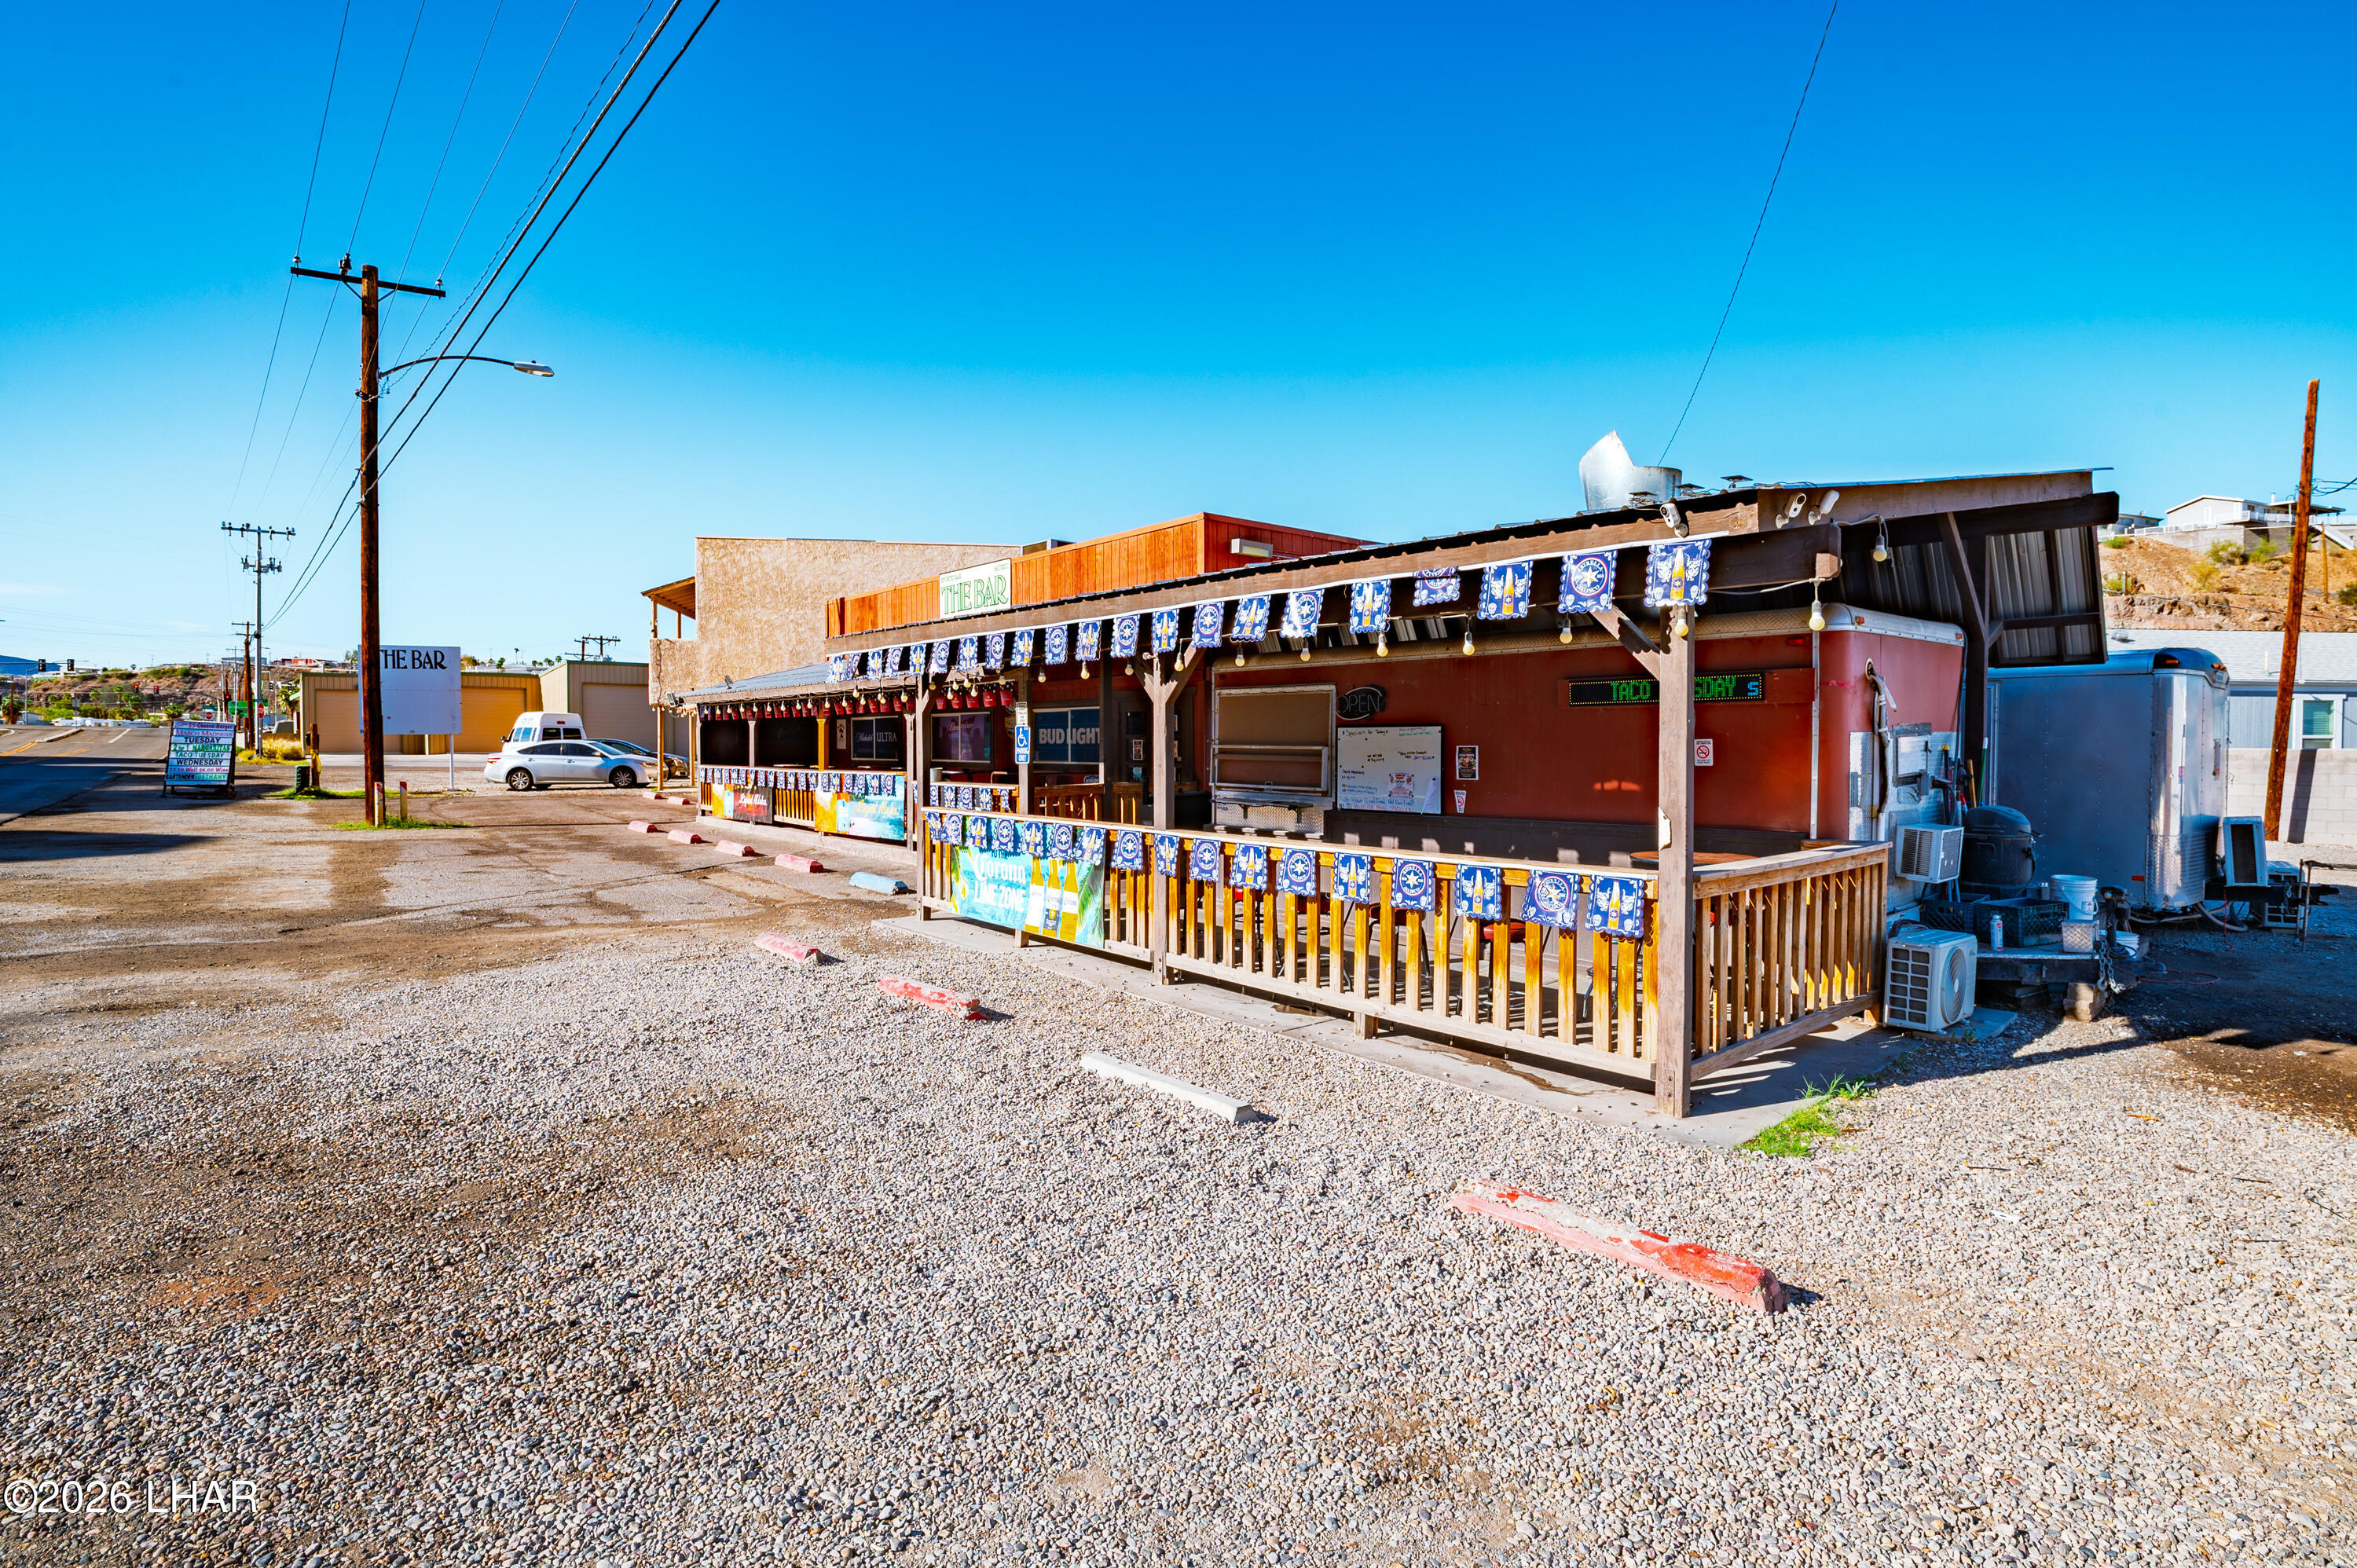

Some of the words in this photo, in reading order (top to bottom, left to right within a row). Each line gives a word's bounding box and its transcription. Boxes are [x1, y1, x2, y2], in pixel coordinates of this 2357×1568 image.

[941, 581, 973, 614] THE
[974, 575, 1009, 609] BAR
[379, 649, 407, 669] HE
[411, 650, 448, 669] BAR
[1610, 681, 1651, 701] TACO
[1694, 676, 1736, 698] SDAY
[1337, 694, 1380, 713] OPEN
[877, 731, 897, 742] ULTRA
[1039, 728, 1065, 745] BUD
[974, 853, 1026, 885] Corona
[974, 881, 998, 906] LIME
[998, 886, 1026, 912] ZONE
